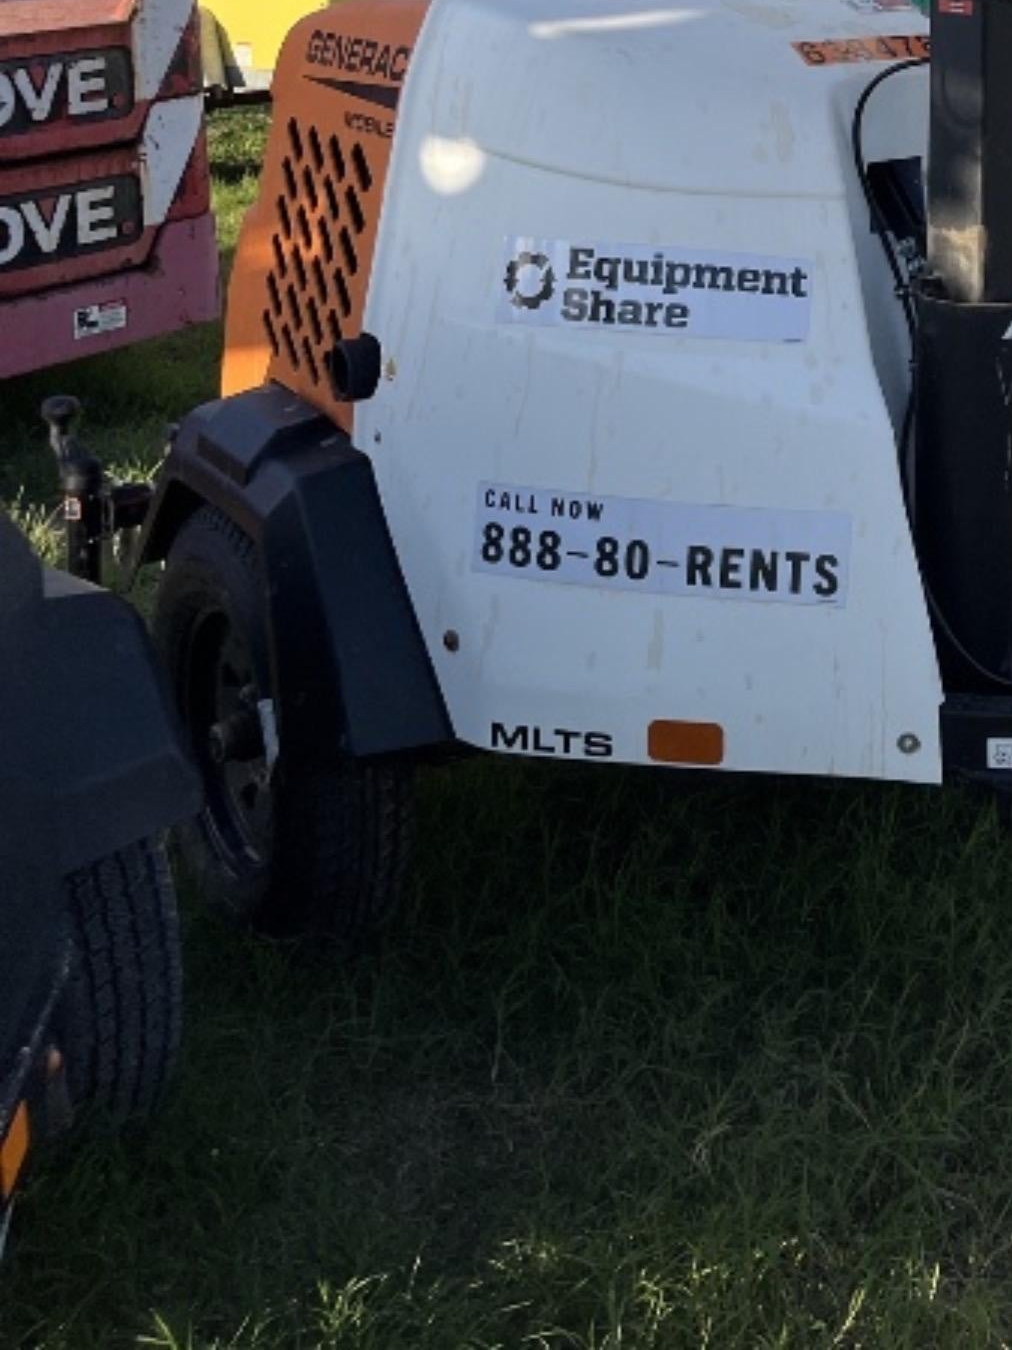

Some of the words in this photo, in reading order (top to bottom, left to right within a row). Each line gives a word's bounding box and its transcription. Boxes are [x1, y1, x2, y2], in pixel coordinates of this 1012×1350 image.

[306, 29, 410, 81] GENERAC
[566, 246, 808, 299] Equipment
[560, 287, 690, 328] Share
[484, 489, 539, 514] CALL
[550, 497, 605, 521] NOW
[481, 521, 840, 597] 888-80-RENTS
[490, 722, 614, 757] MLTS
